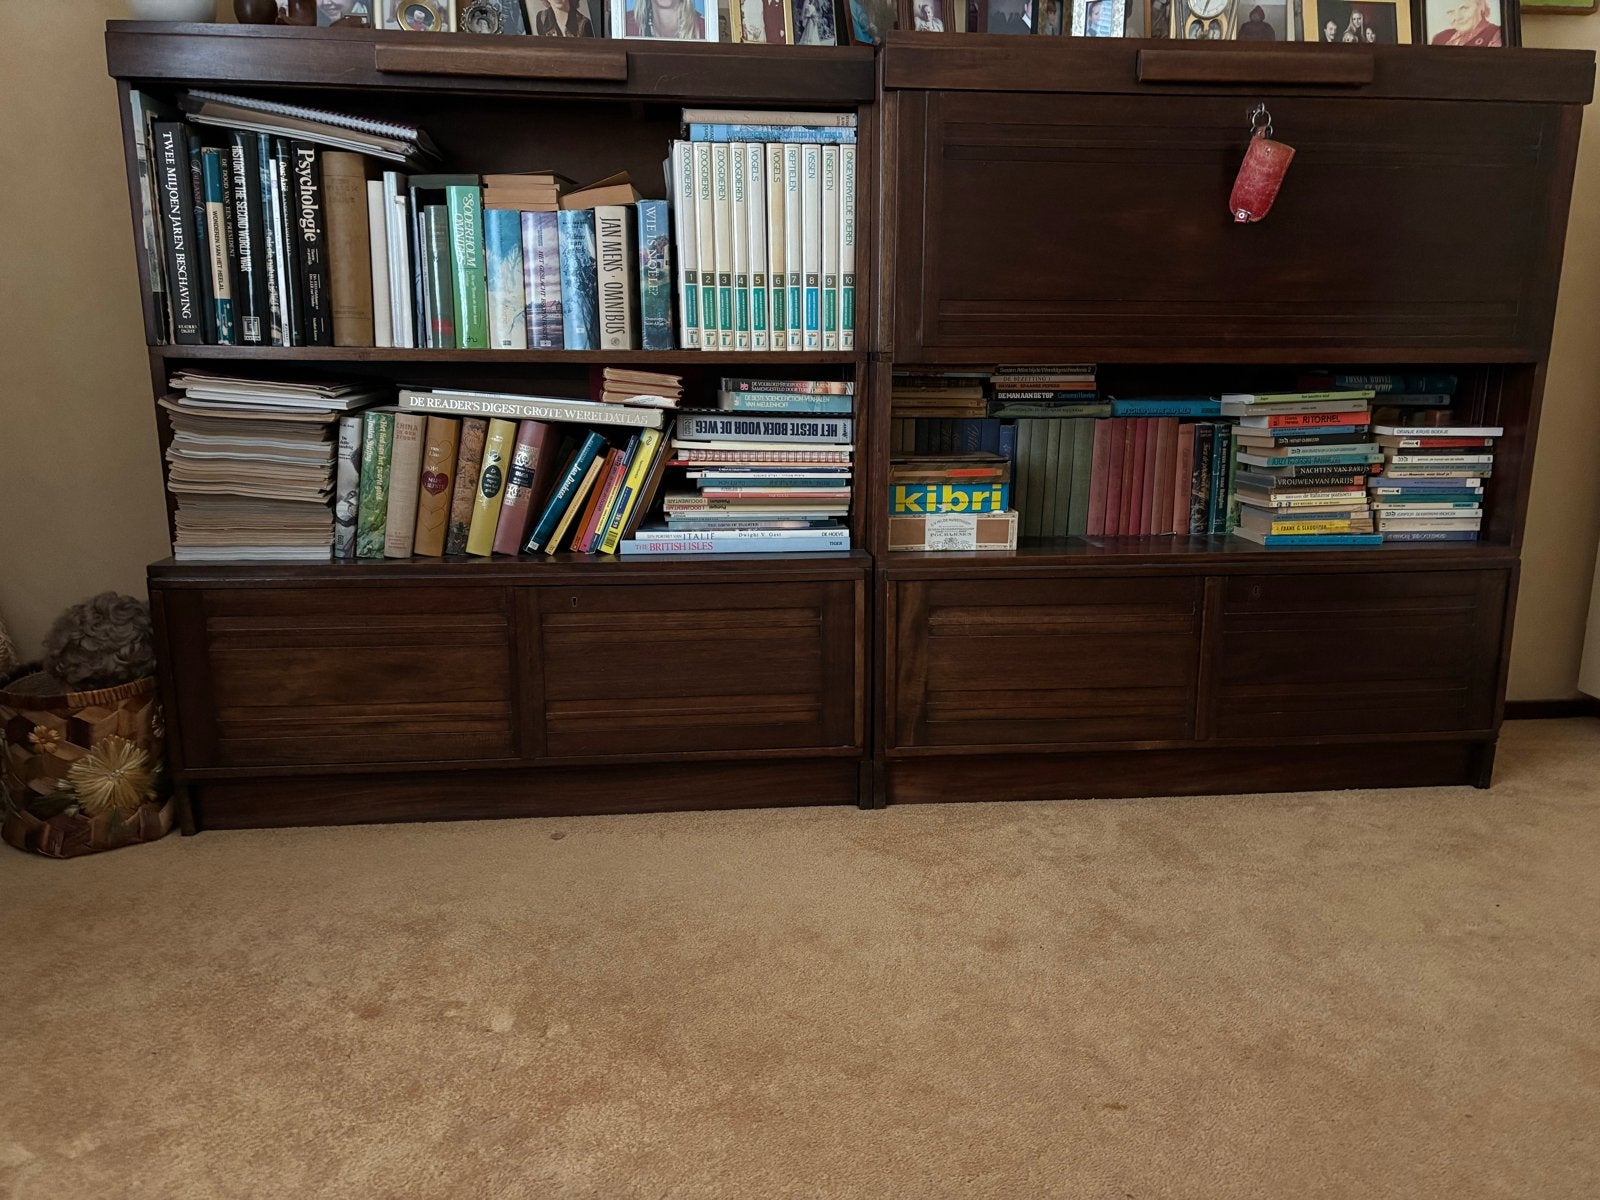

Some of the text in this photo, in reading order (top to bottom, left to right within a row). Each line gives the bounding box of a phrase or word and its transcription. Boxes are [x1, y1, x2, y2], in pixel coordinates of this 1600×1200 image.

[162, 131, 176, 164] TWEE
[683, 146, 692, 198] ZOOGDIEREN
[700, 148, 709, 200] ZOOGDIEREN
[717, 150, 726, 201] ZOOGDIEREN
[735, 151, 743, 202] ZOOGDIEREN
[751, 150, 759, 182] VOGELS
[788, 149, 796, 192] REPTIELEN
[825, 152, 834, 191] INSEKTEN
[165, 167, 181, 214] MILJOEN
[295, 148, 320, 242] Psychologie
[845, 151, 854, 216] ONGEWERVELDE
[231, 145, 252, 272] HISTORY OF THE SECOND WORLD WAR
[646, 206, 657, 232] WIE
[169, 214, 184, 250] JAREN
[212, 210, 220, 244] WONDEREN
[226, 221, 235, 257] PRESIDENT
[647, 234, 657, 246] IS
[175, 253, 191, 319] BESCHAVING
[600, 217, 625, 335] JAN MENS OMNIBUS
[689, 271, 693, 281] 1
[705, 275, 711, 283] 2
[721, 275, 727, 284] 3
[738, 276, 744, 285] 4
[755, 276, 761, 284] 5
[775, 276, 781, 285] 6
[791, 275, 797, 283] 7
[809, 276, 815, 285] 8
[826, 277, 832, 285] 9
[409, 396, 648, 425] DE READER'S DIGEST GROTE WERELDATLAS
[695, 420, 718, 434] WEG
[720, 420, 732, 434] DE
[734, 421, 762, 435] VOOR
[763, 422, 788, 436] BOEK
[790, 422, 818, 437] BESTE
[820, 423, 838, 437] HET
[1277, 478, 1314, 486] VROUWEN
[1300, 466, 1333, 474] NACHTEN
[1348, 465, 1370, 473] PARIJS
[895, 484, 1002, 512] kibri
[649, 543, 686, 552] BRITISH
[688, 542, 714, 551] ISLES
